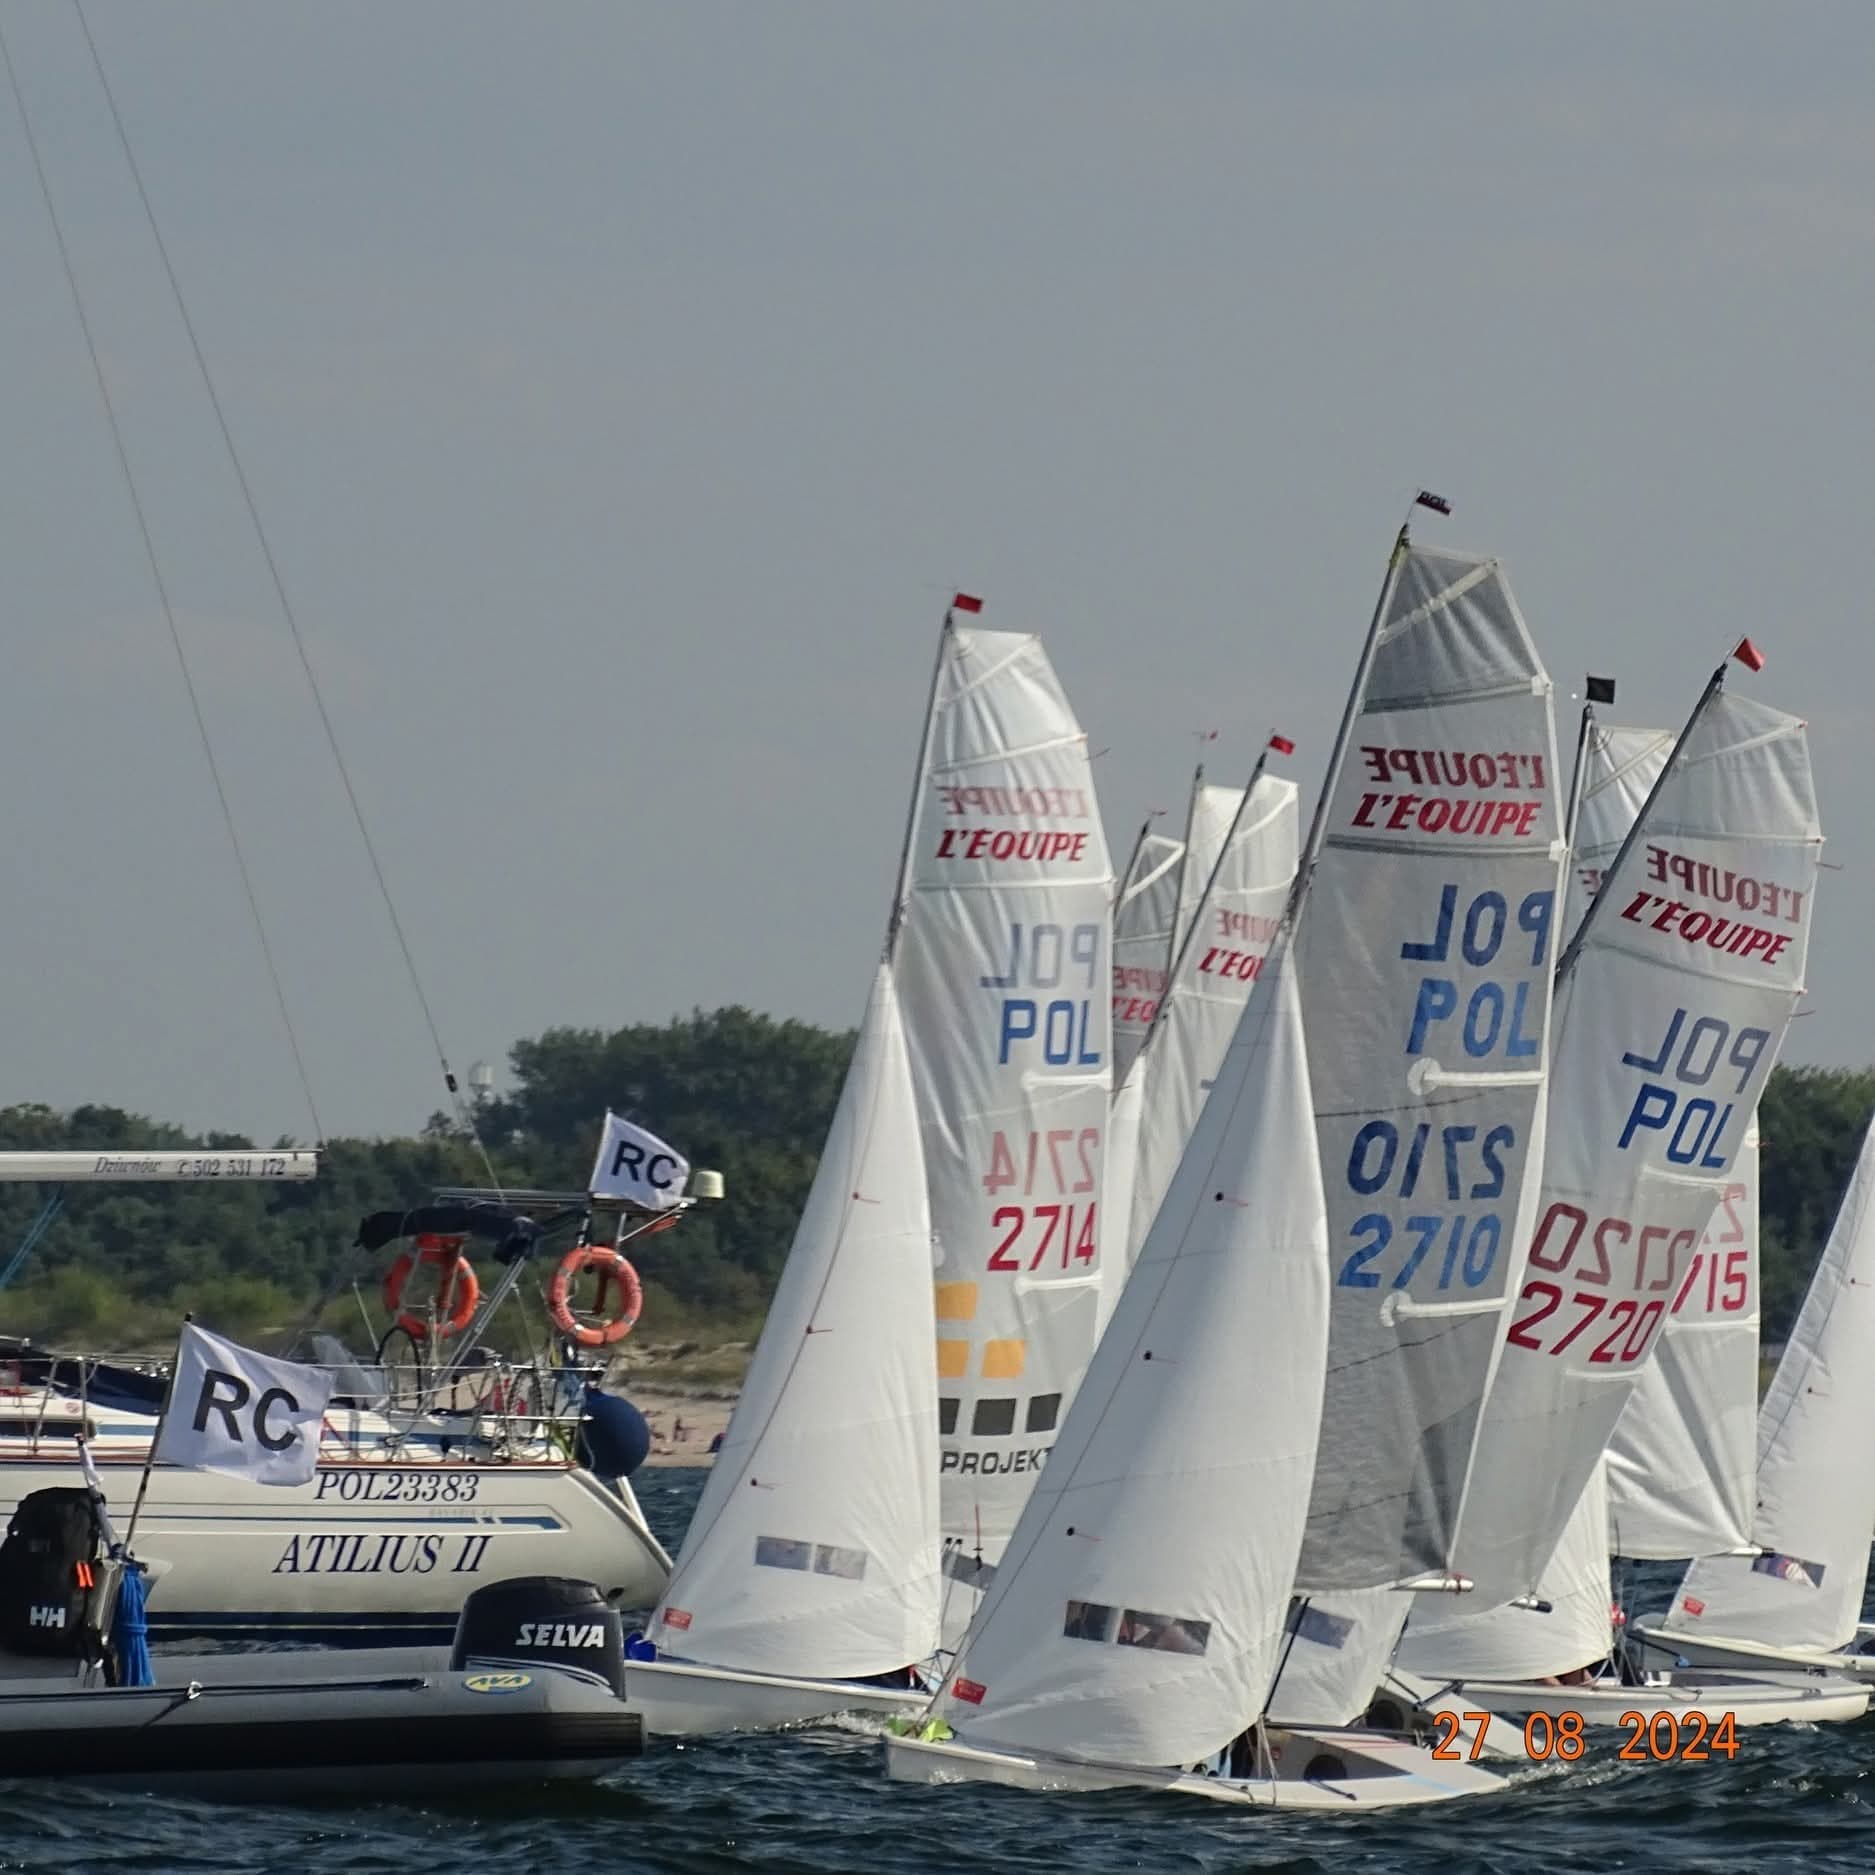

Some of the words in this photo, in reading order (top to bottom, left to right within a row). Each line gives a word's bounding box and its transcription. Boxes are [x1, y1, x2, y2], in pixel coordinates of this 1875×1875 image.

[998, 999, 1101, 1065] POL
[1406, 978, 1540, 1059] POL
[1617, 1083, 1734, 1169] POL
[193, 1159, 221, 1177] 502
[226, 1159, 250, 1177] 531
[260, 1158, 286, 1177] 172
[610, 1139, 679, 1190] RC
[986, 1201, 1097, 1272] 2714
[1337, 1213, 1502, 1290] 2710
[1506, 1281, 1666, 1363] 2720
[191, 1369, 302, 1451] RC
[314, 1471, 480, 1501] POL23383
[272, 1534, 444, 1573] ATILIUS
[451, 1535, 494, 1572] II
[30, 1605, 66, 1628] HH
[515, 1623, 605, 1648] SELVA
